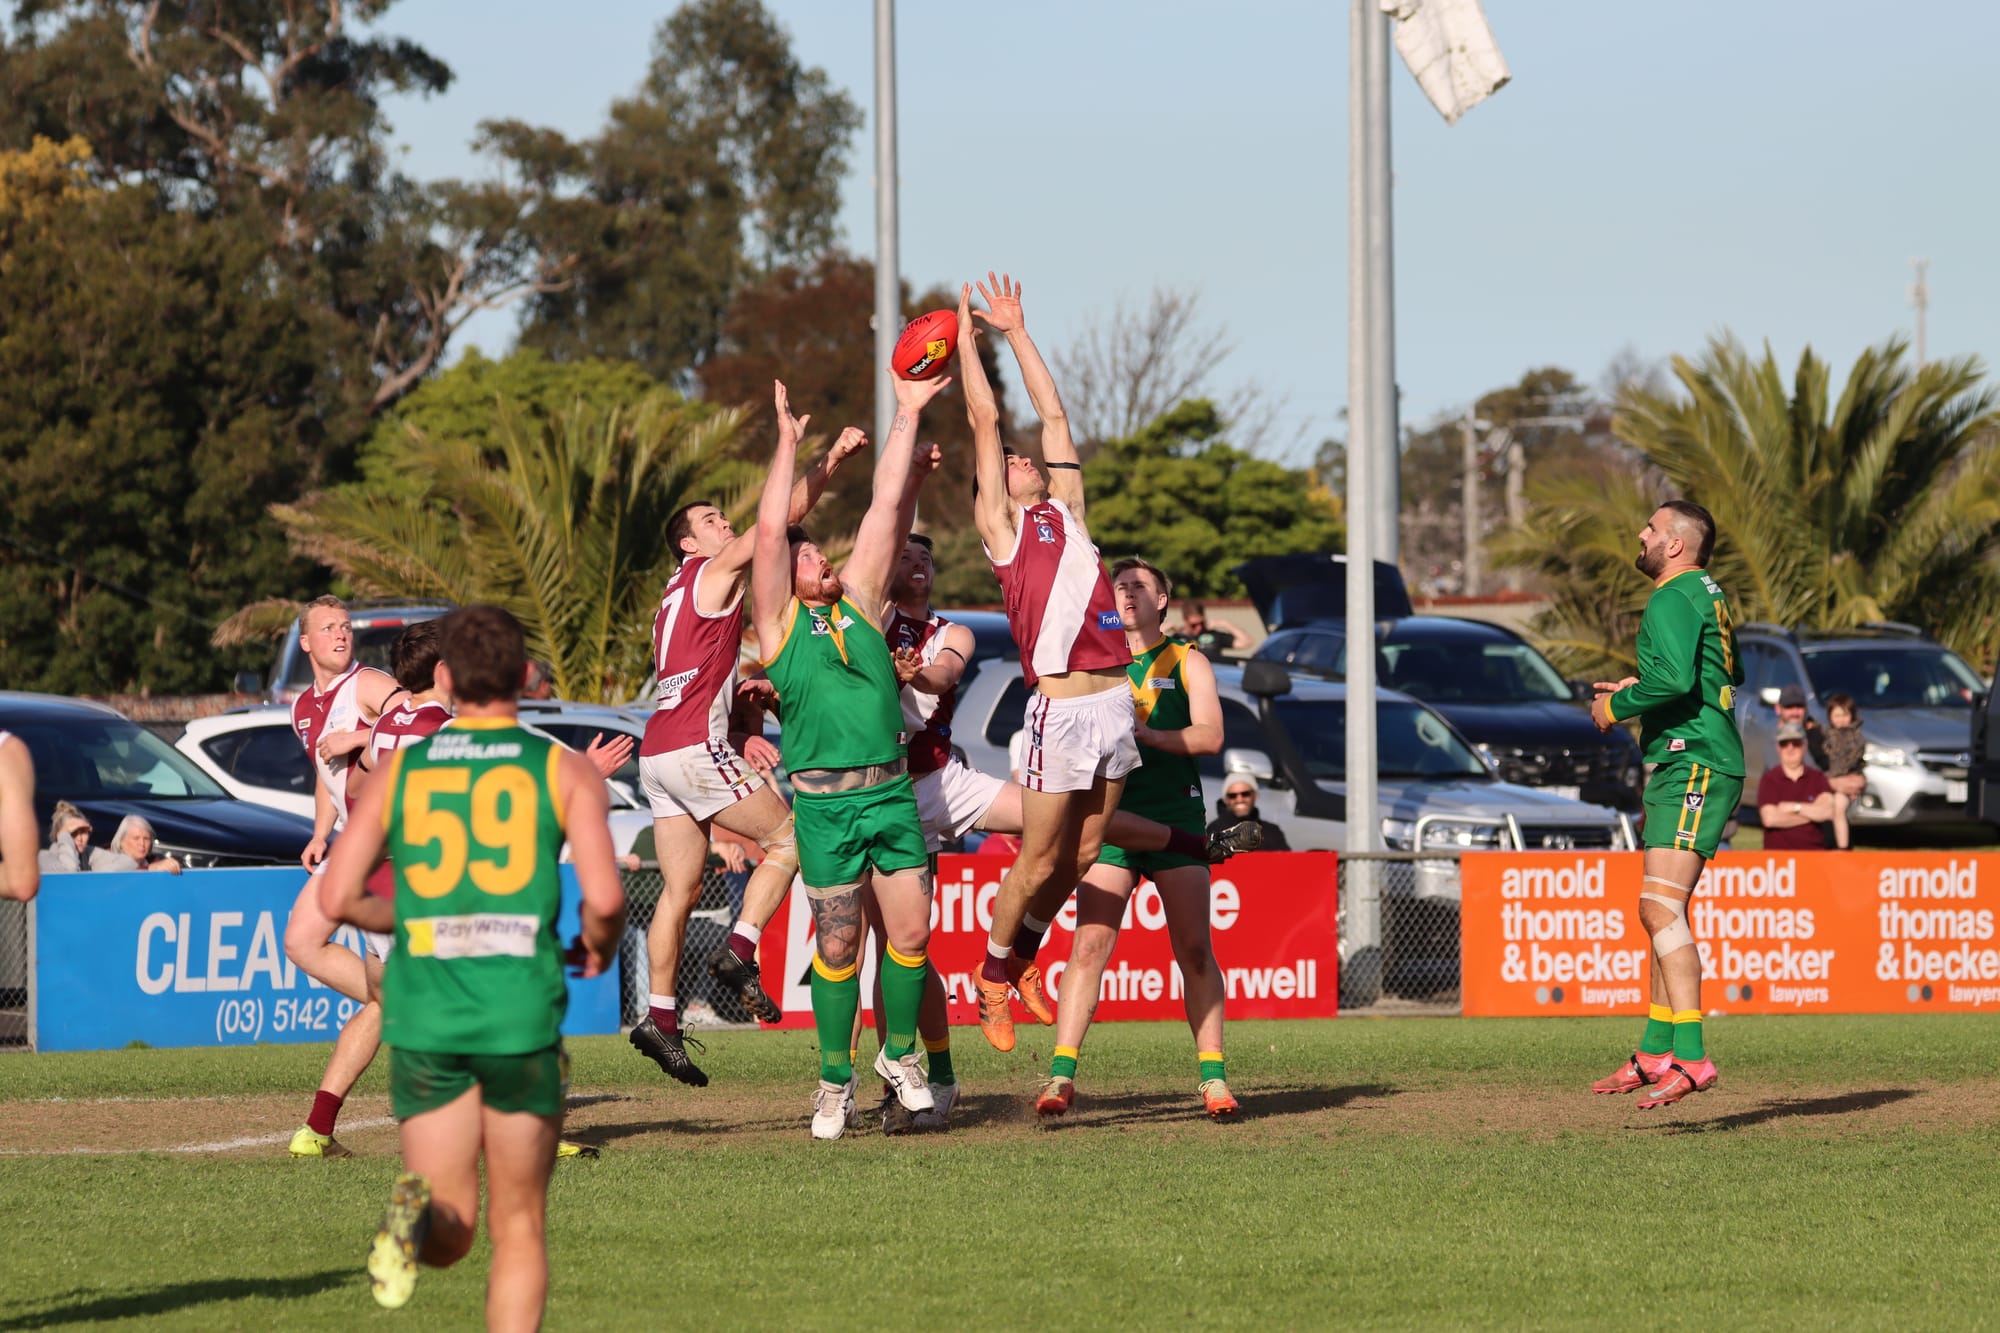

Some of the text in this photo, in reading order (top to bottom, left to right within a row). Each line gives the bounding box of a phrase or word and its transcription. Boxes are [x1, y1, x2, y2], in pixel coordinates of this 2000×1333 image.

[403, 765, 538, 898] 59
[1501, 860, 1605, 898] arnold
[1694, 858, 1796, 898] arnold
[1879, 859, 1977, 898] arnold
[1501, 901, 1625, 940] thomas
[1692, 899, 1815, 939] thomas
[1879, 900, 1994, 939] thomas
[1045, 961, 1163, 1001] Cntre
[1904, 942, 2000, 981] becke
[1581, 985, 1642, 1008] lawyers
[1769, 984, 1830, 1007] lawyers
[1949, 984, 2000, 1007] lawyer
[216, 998, 264, 1042] (03)
[273, 997, 330, 1032] 5142
